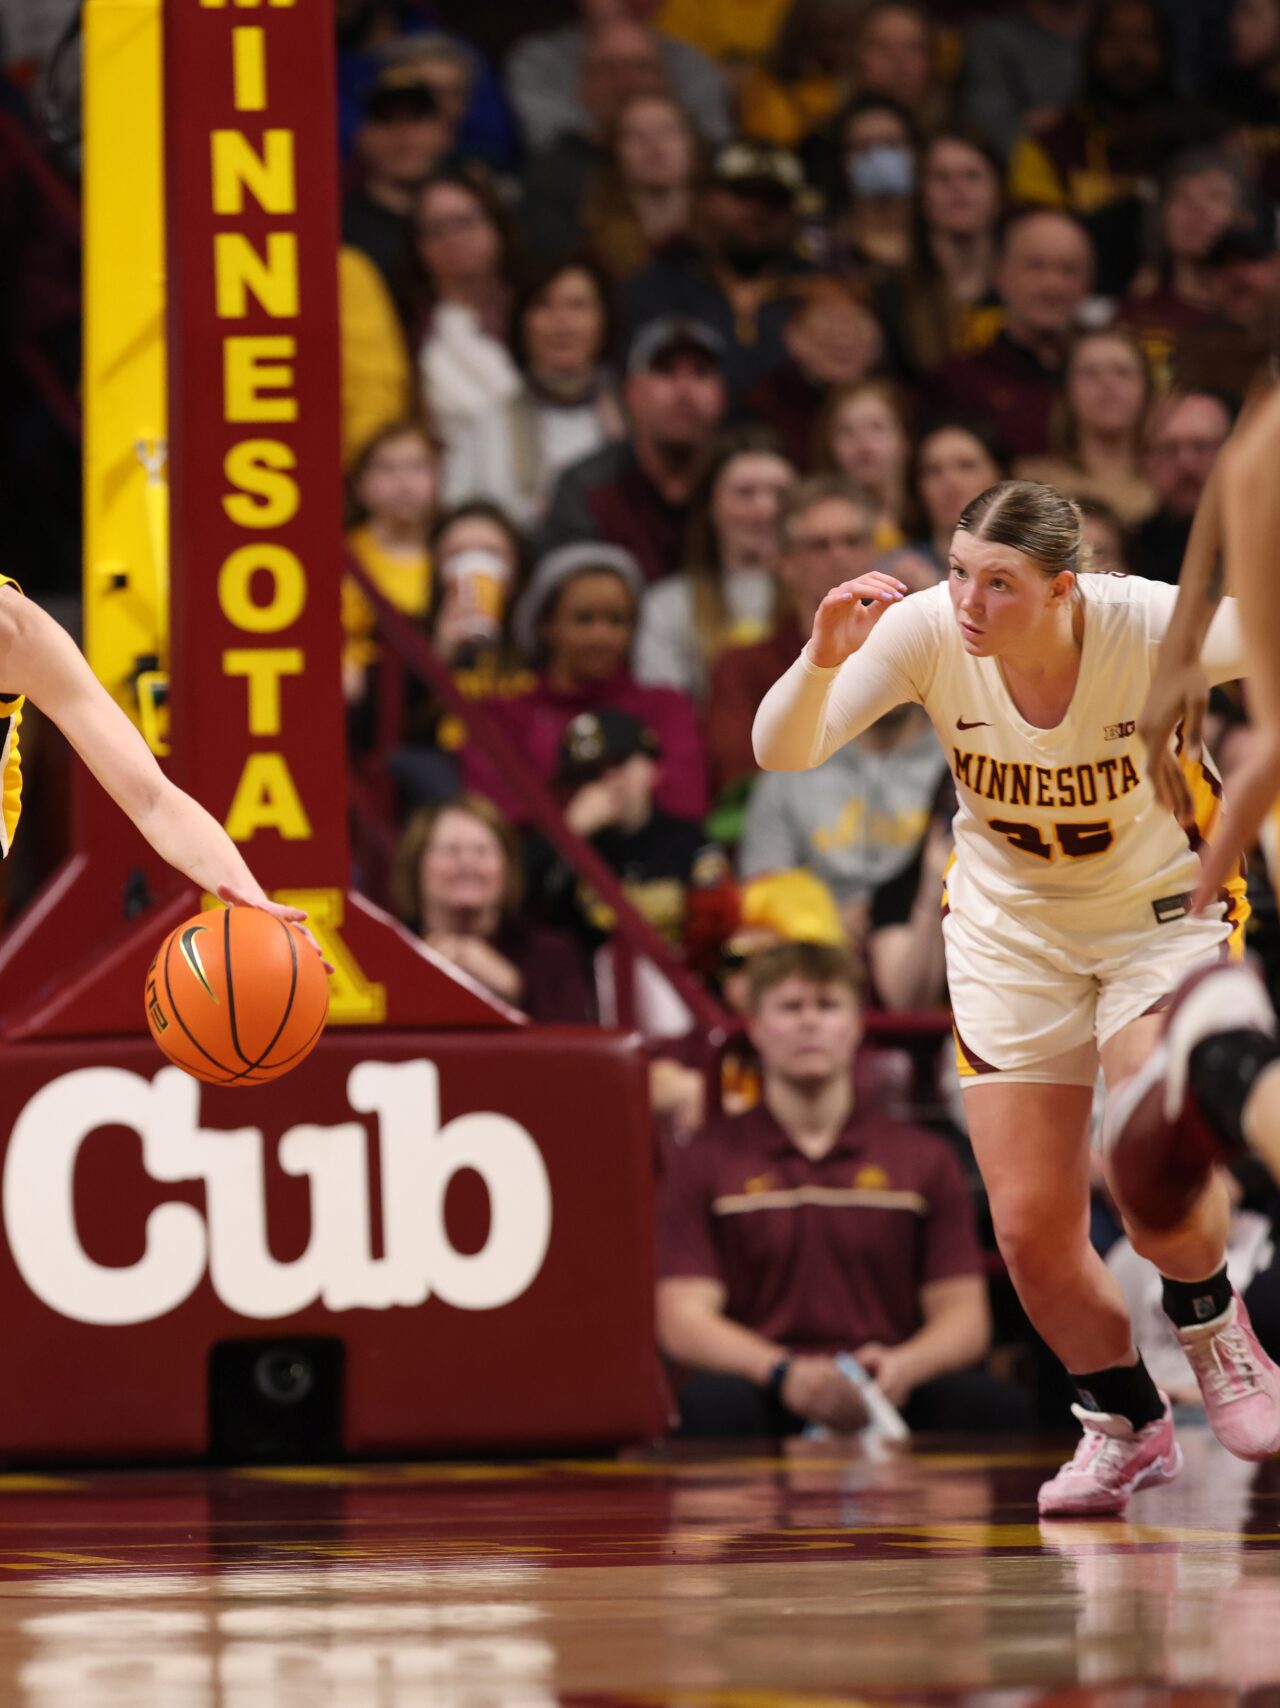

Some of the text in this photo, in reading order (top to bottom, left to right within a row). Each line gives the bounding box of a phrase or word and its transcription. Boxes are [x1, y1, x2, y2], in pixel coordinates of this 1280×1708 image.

[199, 0, 312, 841] INNESOTA
[952, 746, 1140, 808] MINNESOTA
[2, 1058, 553, 1326] Cub
